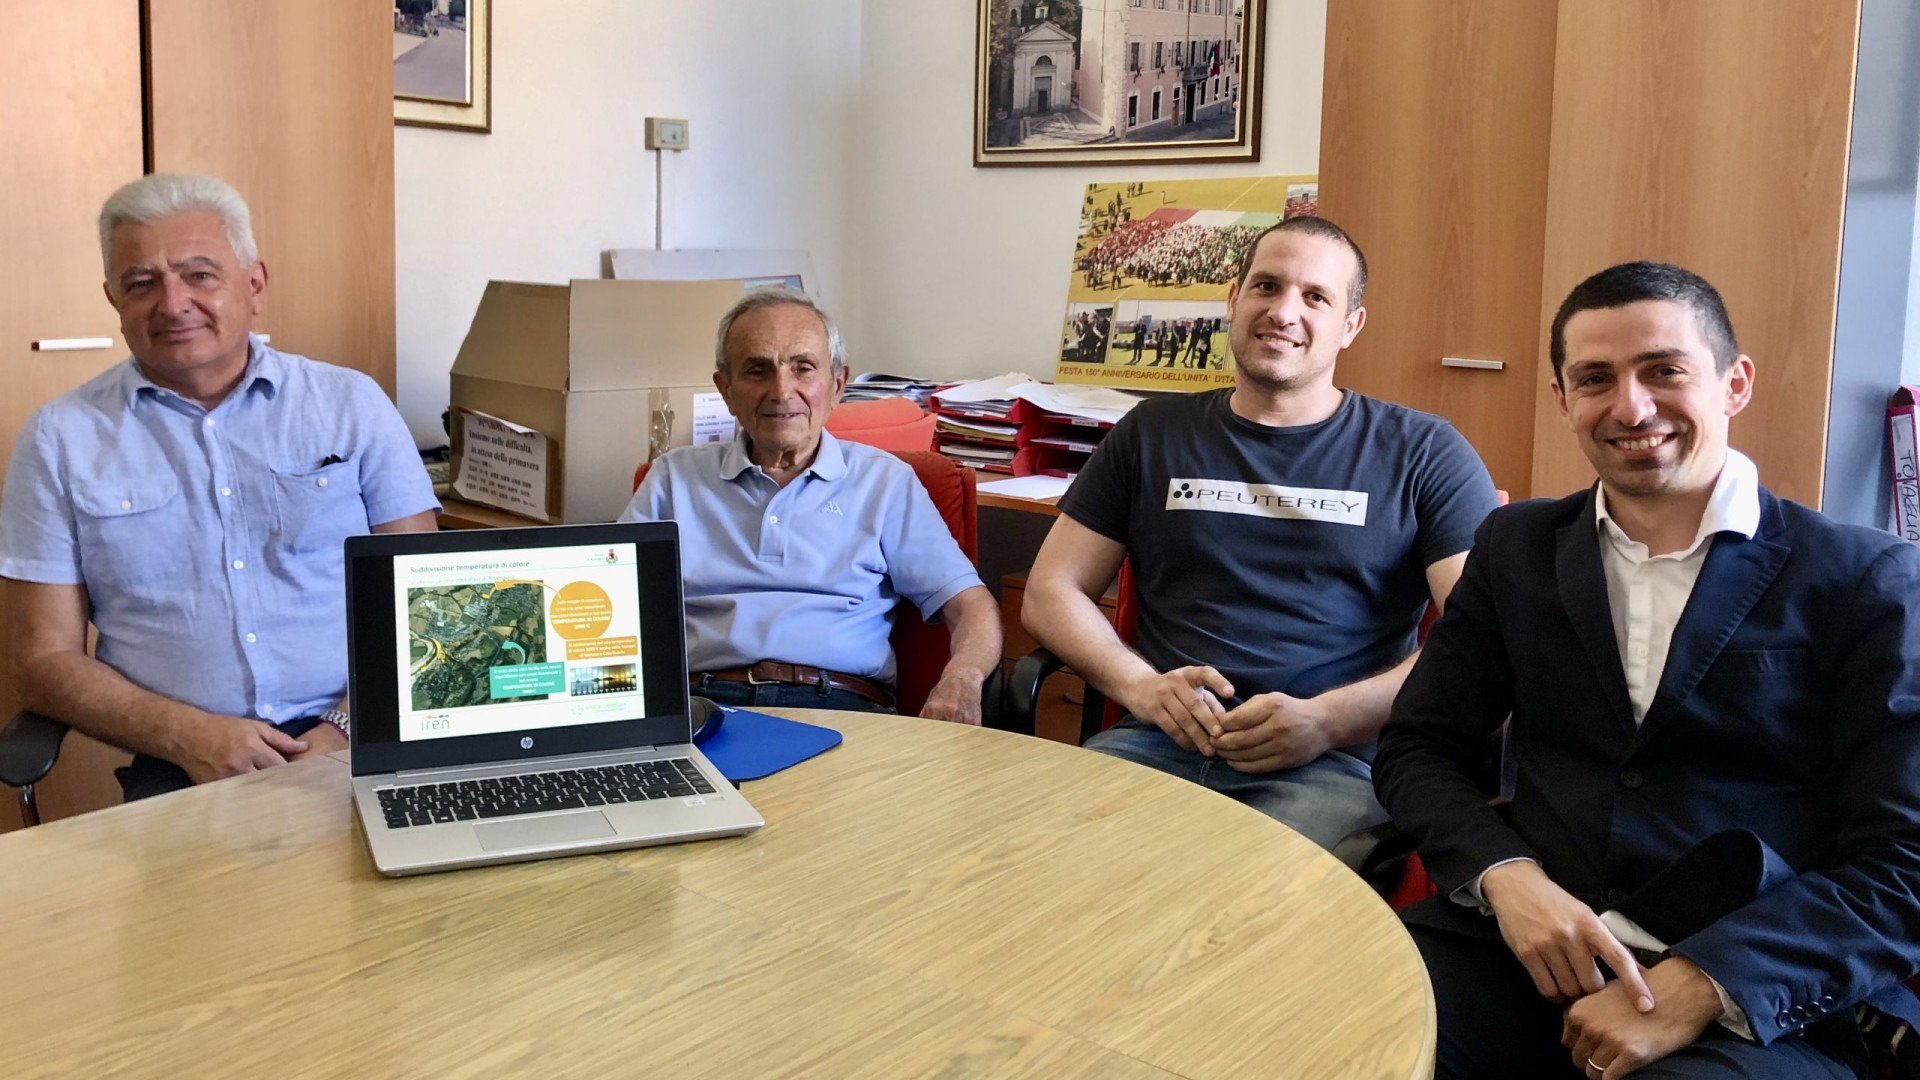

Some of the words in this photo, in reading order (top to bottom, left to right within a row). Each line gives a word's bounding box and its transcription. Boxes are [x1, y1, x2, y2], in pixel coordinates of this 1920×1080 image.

[1059, 366, 1082, 376] FESTA
[1102, 370, 1160, 380] ANNIVERSARIO
[1215, 376, 1235, 384] D'ITA
[494, 450, 507, 463] della
[509, 456, 539, 471] primavera
[1197, 489, 1360, 513] PEUTEREY
[410, 565, 454, 574] Suddivisione
[456, 563, 499, 571] temperatura
[520, 736, 534, 749] hp
